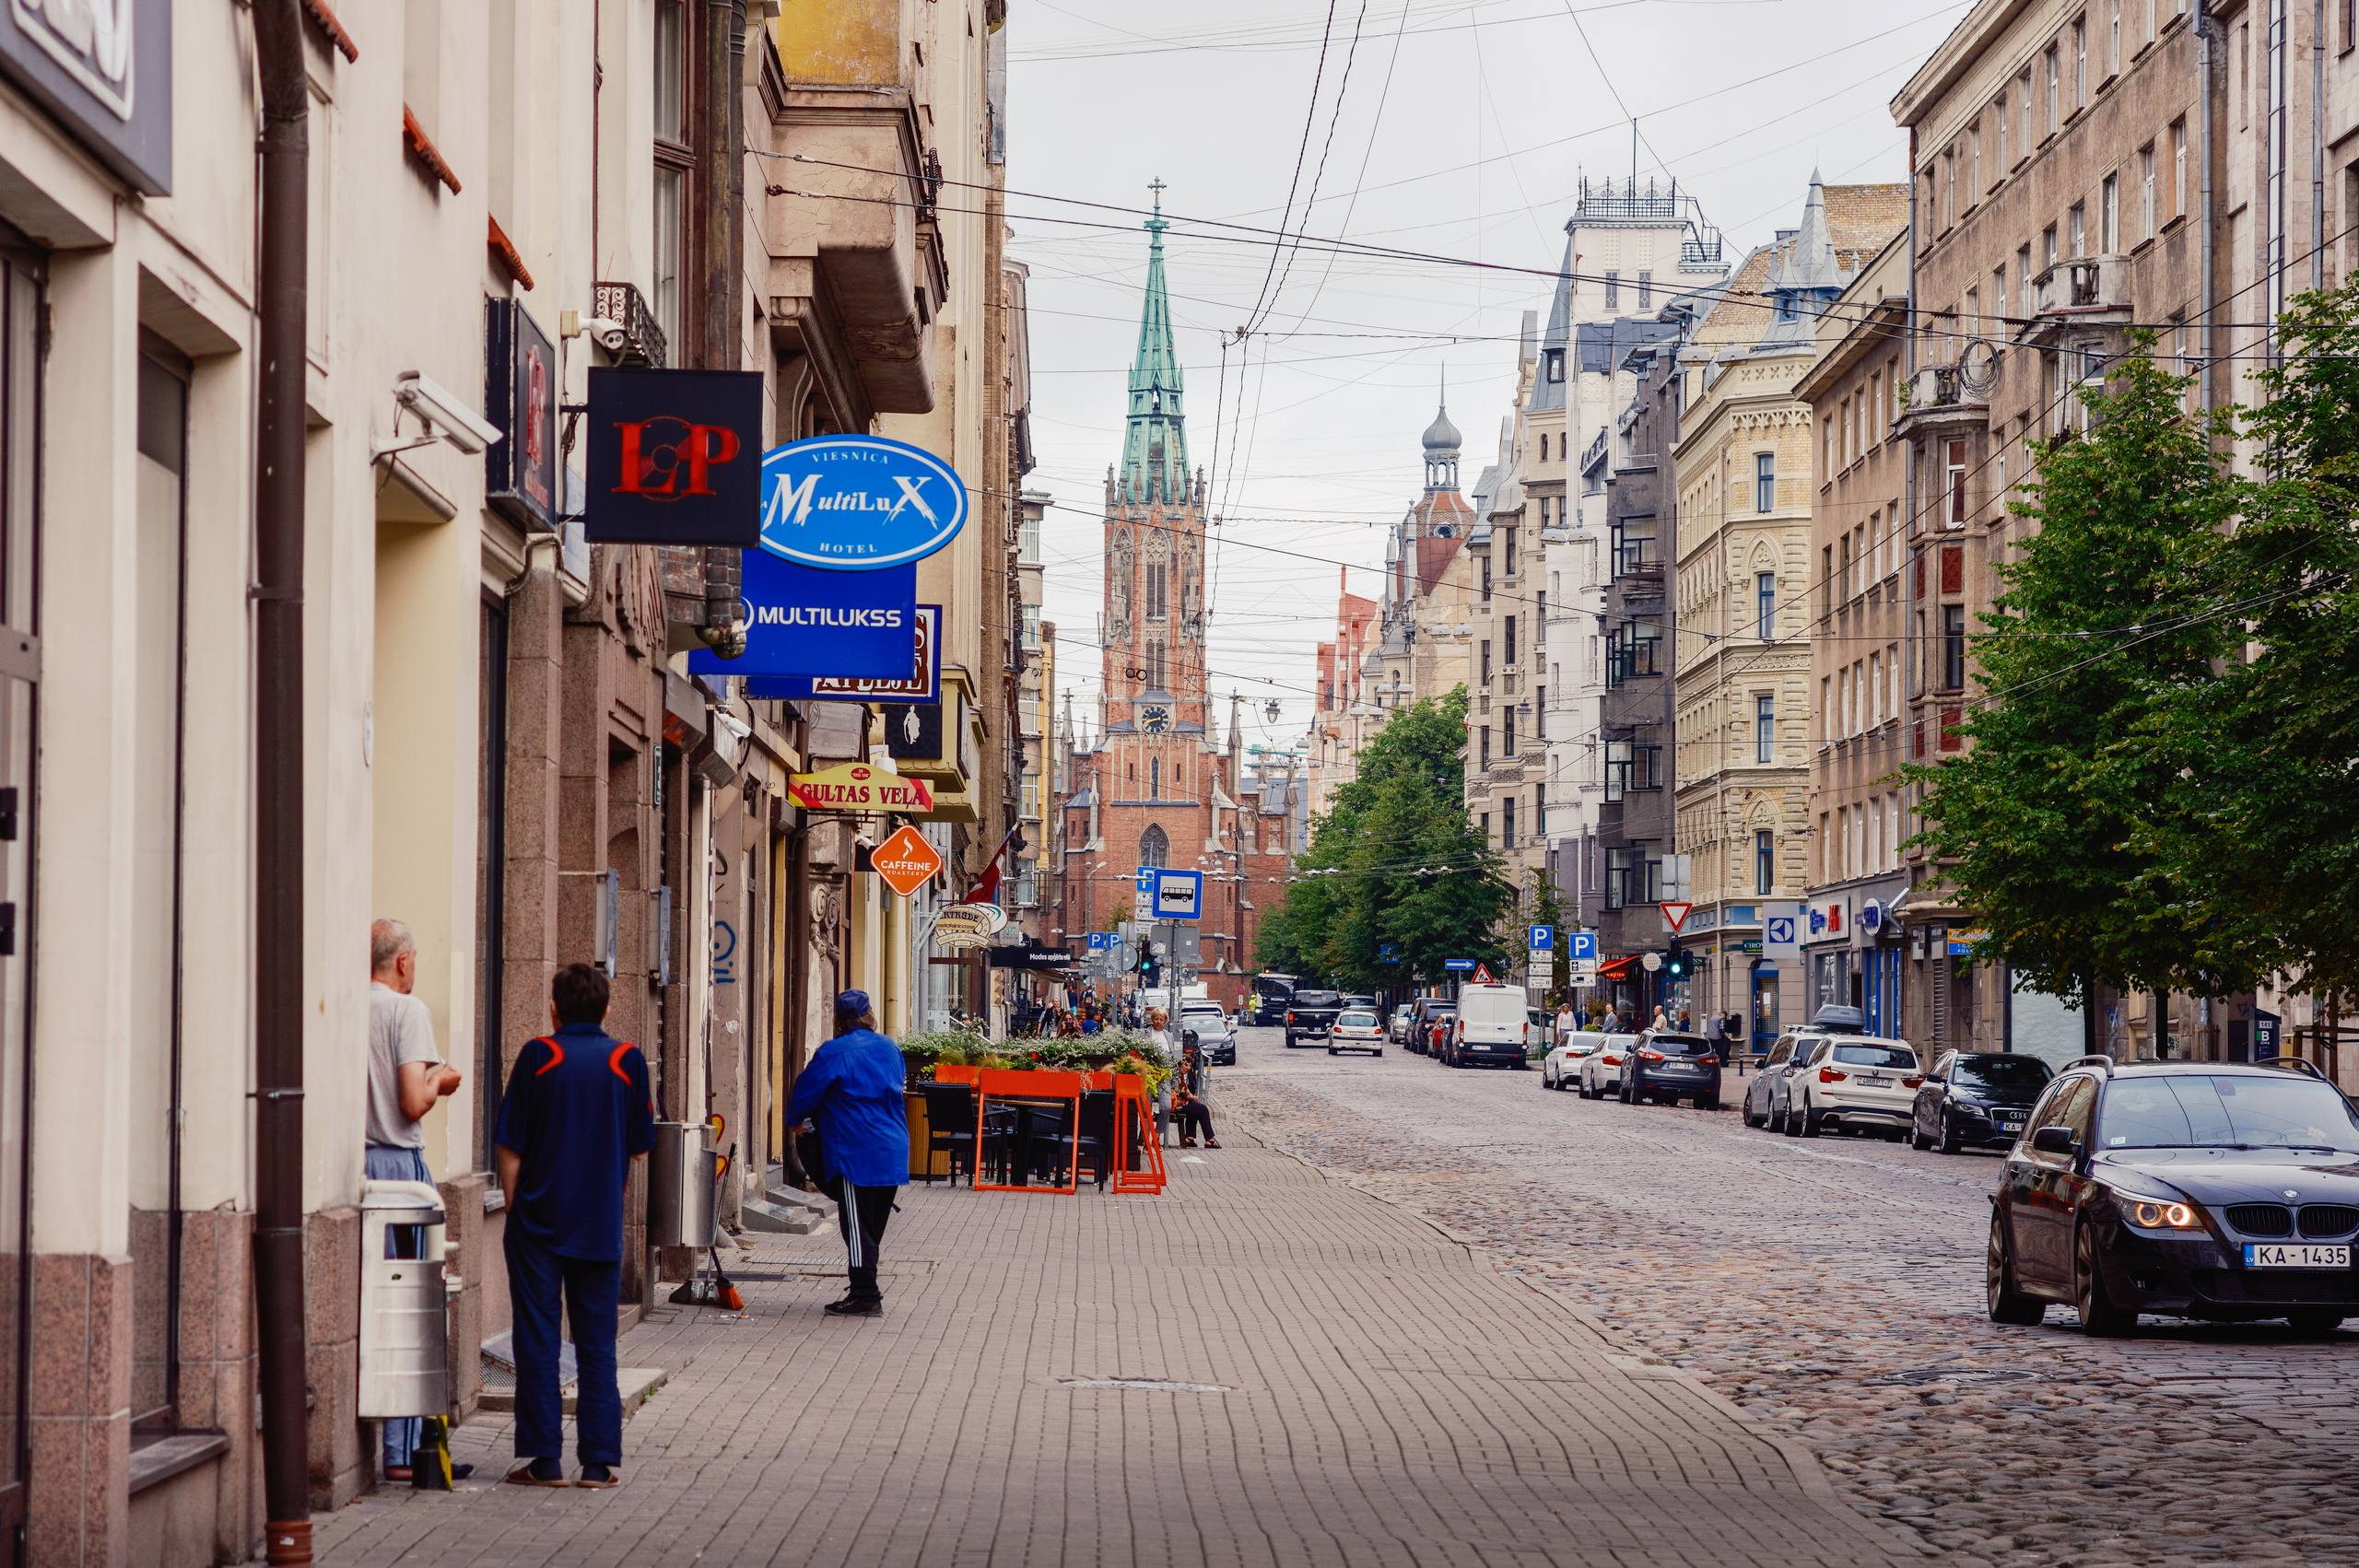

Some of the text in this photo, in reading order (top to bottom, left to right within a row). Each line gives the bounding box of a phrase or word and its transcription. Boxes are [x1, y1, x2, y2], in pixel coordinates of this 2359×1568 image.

[812, 451, 888, 464] VIESNĪCA
[761, 473, 940, 532] MultiLuX
[819, 542, 878, 554] HOTEL
[757, 605, 902, 627] MULTILUKSS
[799, 783, 925, 809] GULTAS VEĻA
[881, 860, 931, 872] CAFFEINE
[1142, 869, 1154, 889] P
[1091, 933, 1101, 947] P
[1109, 934, 1119, 948] P
[1534, 928, 1548, 946] P
[1575, 936, 1590, 956] P
[2261, 1030, 2270, 1041] B
[2259, 1246, 2347, 1264] KA-1435
